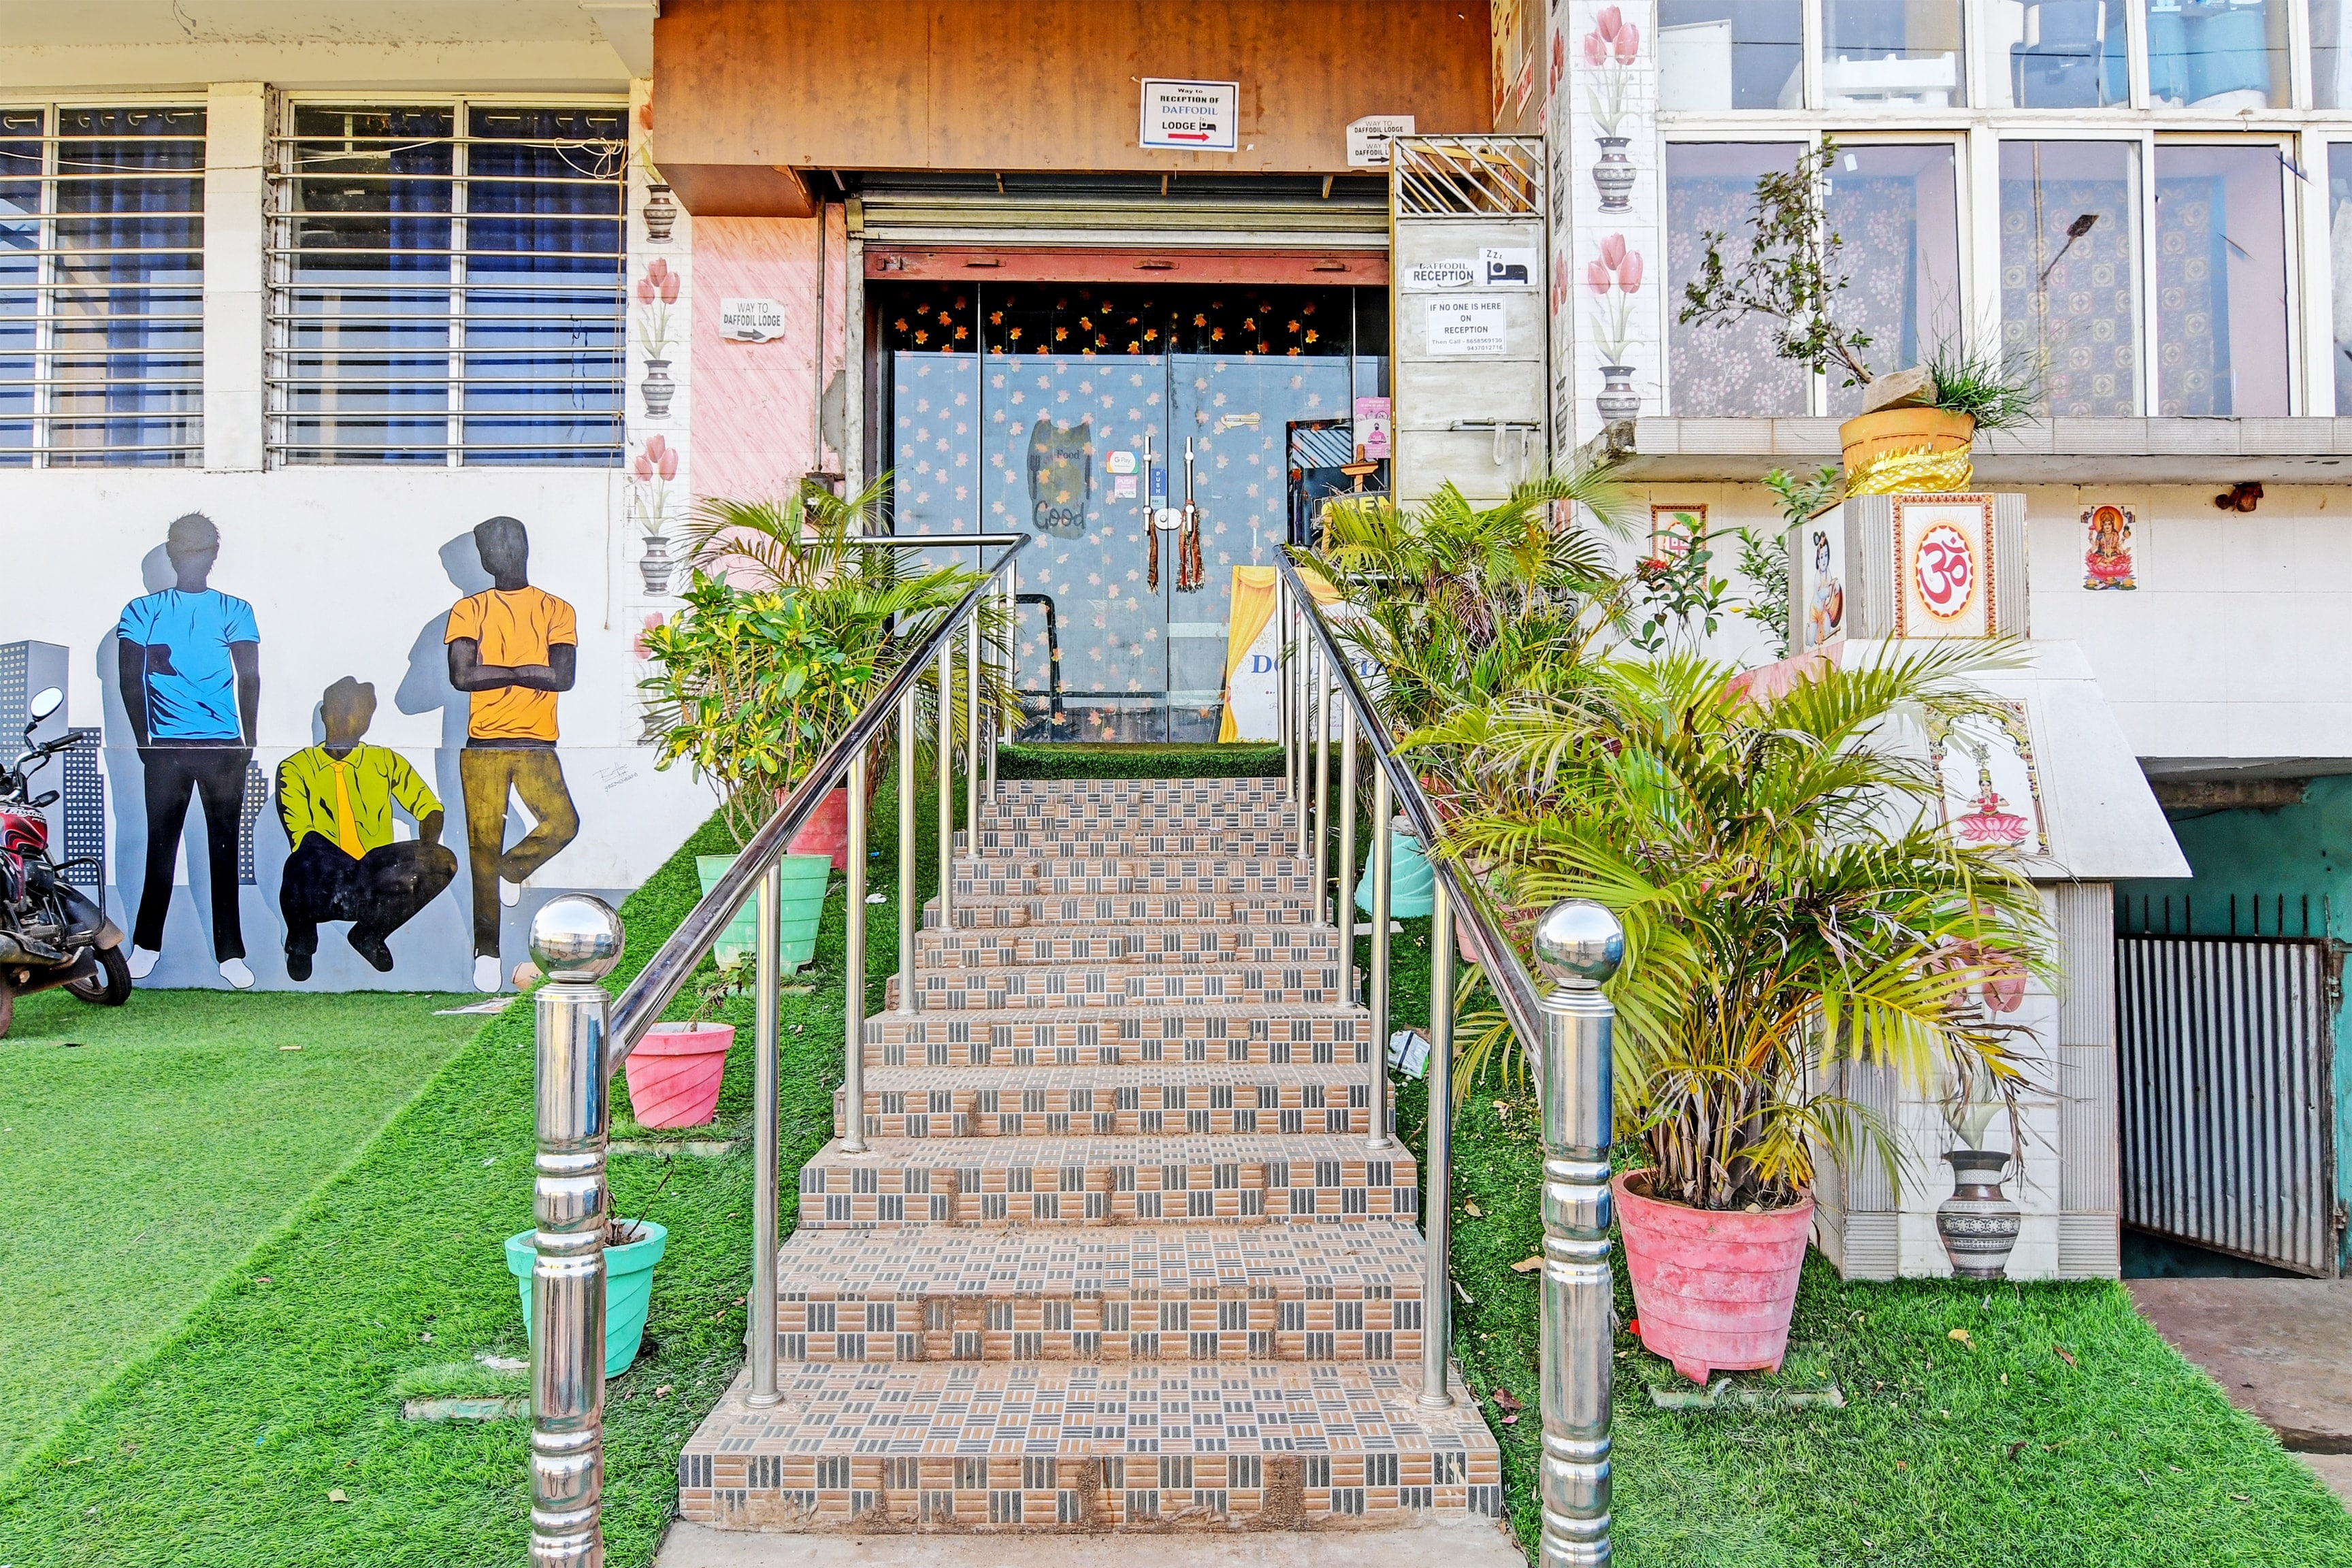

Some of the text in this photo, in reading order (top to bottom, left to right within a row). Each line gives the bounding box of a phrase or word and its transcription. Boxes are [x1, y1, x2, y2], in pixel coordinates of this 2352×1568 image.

[1160, 95, 1207, 103] RECEPTION
[1162, 105, 1218, 115] DAFFODIL
[1162, 121, 1196, 130] LODGE
[1414, 270, 1473, 281] RECEPTION
[737, 303, 768, 313] WAY TO
[723, 314, 781, 326] DAFFODIL LODGE
[1057, 449, 1081, 459] Food
[1121, 456, 1131, 464] Pay
[1035, 500, 1085, 529] Good
